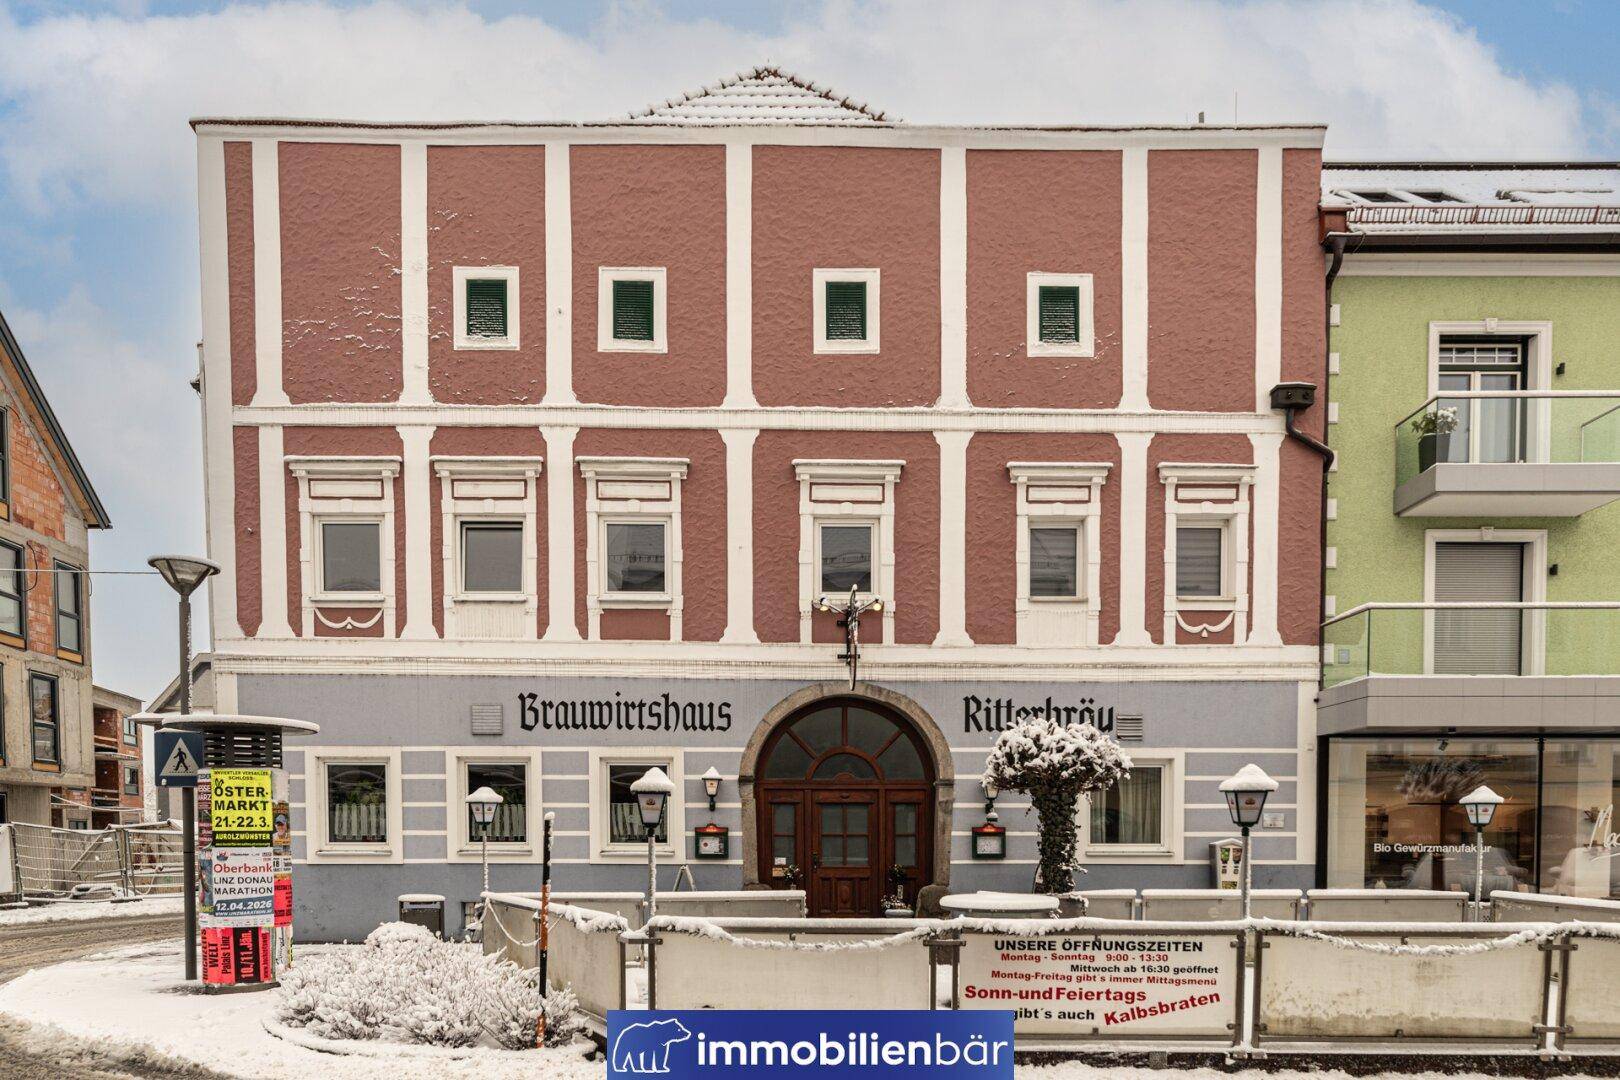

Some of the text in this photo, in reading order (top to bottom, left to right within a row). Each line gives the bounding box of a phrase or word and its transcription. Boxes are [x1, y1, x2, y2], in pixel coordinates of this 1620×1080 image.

[517, 691, 732, 732] Brauwirtshaus
[214, 800, 269, 811] MARKT
[1373, 842, 1491, 853] Bio Gewürzmanufakur
[213, 863, 272, 873] Oberbank
[214, 876, 273, 885] LINZ DONAU
[215, 900, 272, 911] 12.04.2026
[994, 938, 1203, 952] UNSERE ÖFFNUNGSZEITEN
[208, 942, 219, 968] WELT
[1001, 953, 1041, 963] Montag
[1051, 952, 1095, 963] Sonntag
[1105, 953, 1129, 962] 9:00
[1139, 953, 1169, 962] 13:30
[1070, 964, 1219, 975] Mittwoch ab 16:30 geöffnet
[991, 970, 1073, 983] Montag-Freitag
[1109, 975, 1143, 984] immer
[1146, 976, 1217, 987] Mittagsmenü
[1055, 986, 1147, 1005] Feiertags
[1057, 1009, 1095, 1020] auch
[1104, 991, 1221, 1026] Kalbsbraten
